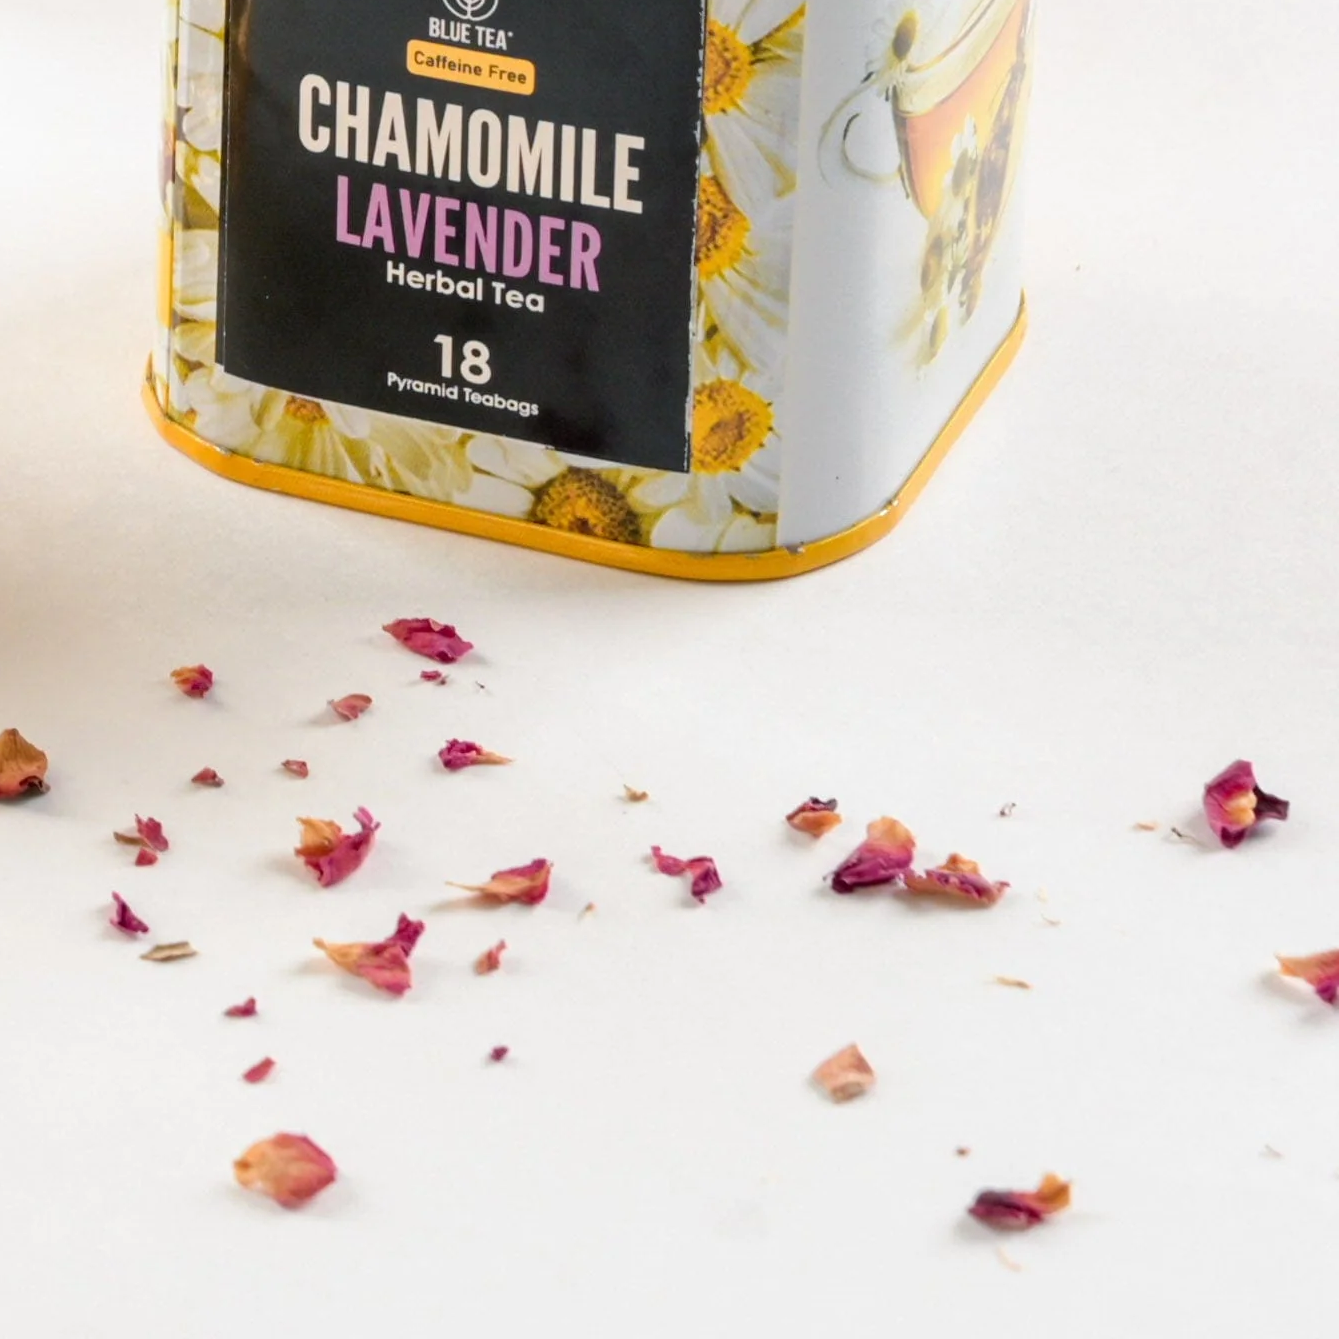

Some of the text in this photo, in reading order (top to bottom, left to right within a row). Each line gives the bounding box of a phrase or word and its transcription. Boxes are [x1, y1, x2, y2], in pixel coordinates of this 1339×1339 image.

[428, 16, 472, 44] BLUE
[414, 50, 528, 85] Caffeine Free
[298, 73, 646, 215] CHAMOMILE
[336, 175, 603, 293] LAVENDER
[386, 261, 546, 314] Herbal Tea
[433, 333, 493, 386] 18
[386, 371, 541, 418] Pyramid Teabags
